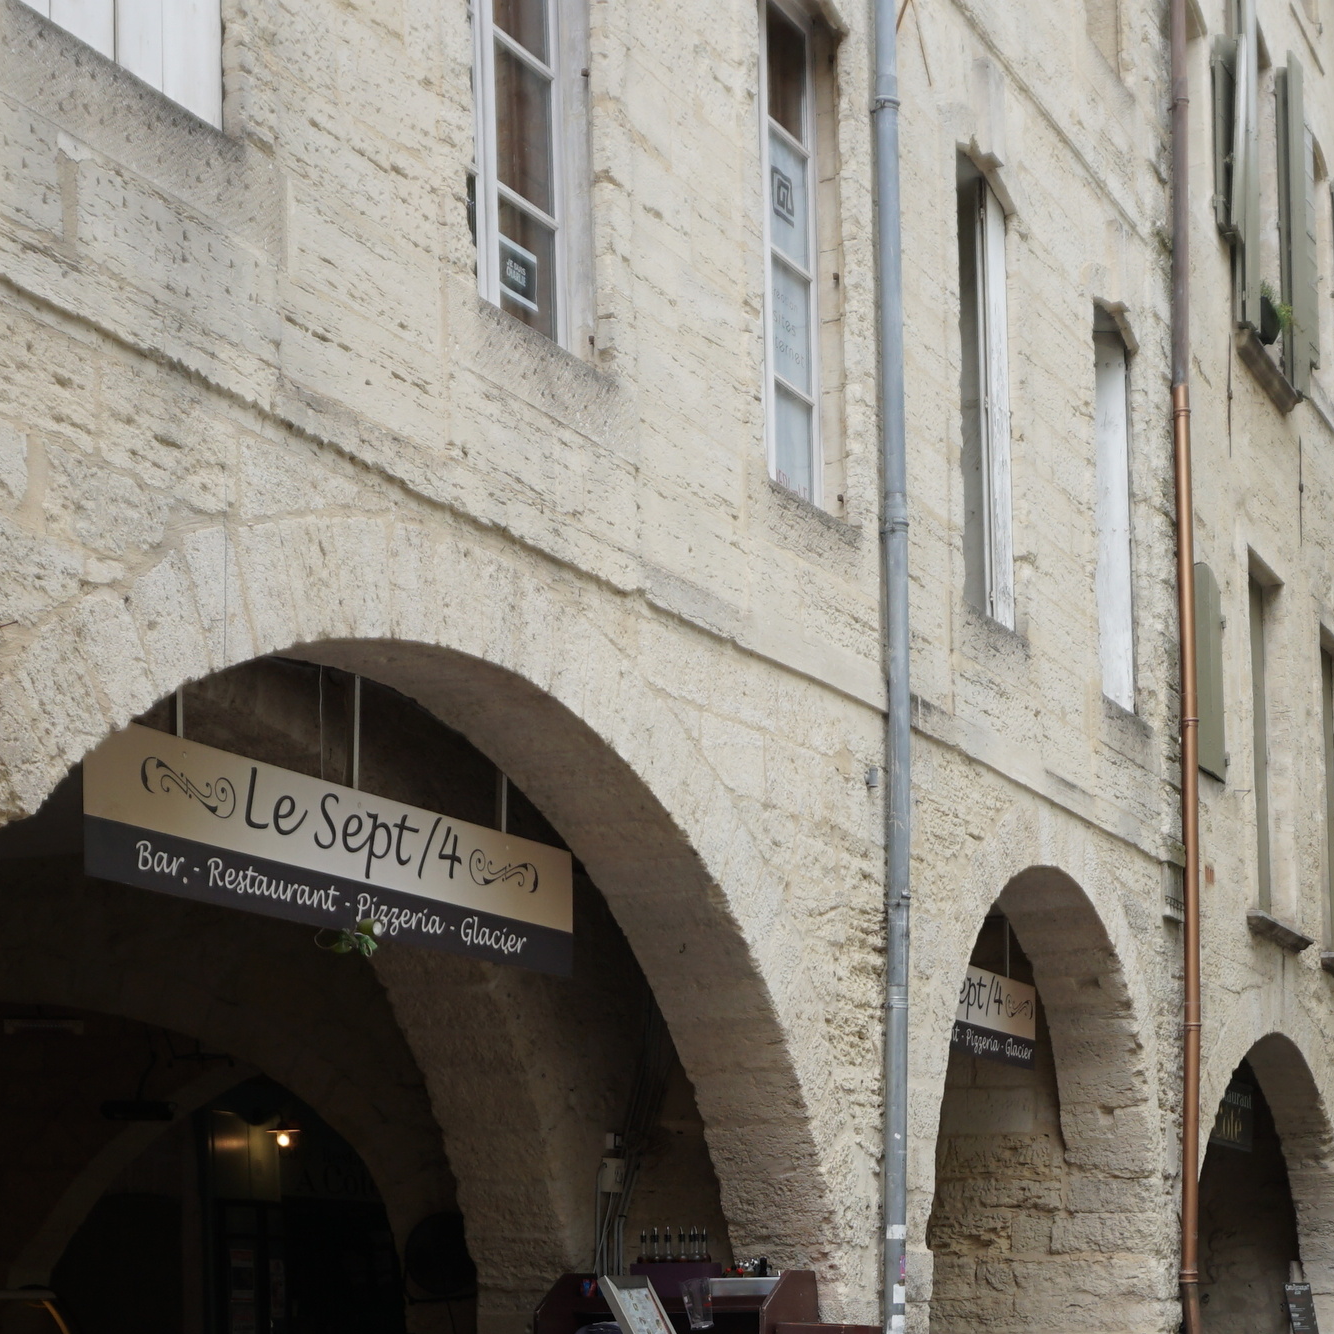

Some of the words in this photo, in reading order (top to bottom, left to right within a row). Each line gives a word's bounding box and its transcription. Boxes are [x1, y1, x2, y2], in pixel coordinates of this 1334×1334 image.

[245, 766, 308, 836] Le
[135, 840, 185, 877] Bar
[207, 857, 340, 911] Restaurant
[356, 893, 446, 935] Pizzeria
[460, 916, 527, 954] Glacier
[959, 975, 1003, 1020] ept/4
[966, 1028, 1000, 1054] Pizzeria
[1005, 1037, 1033, 1059] Glacier
